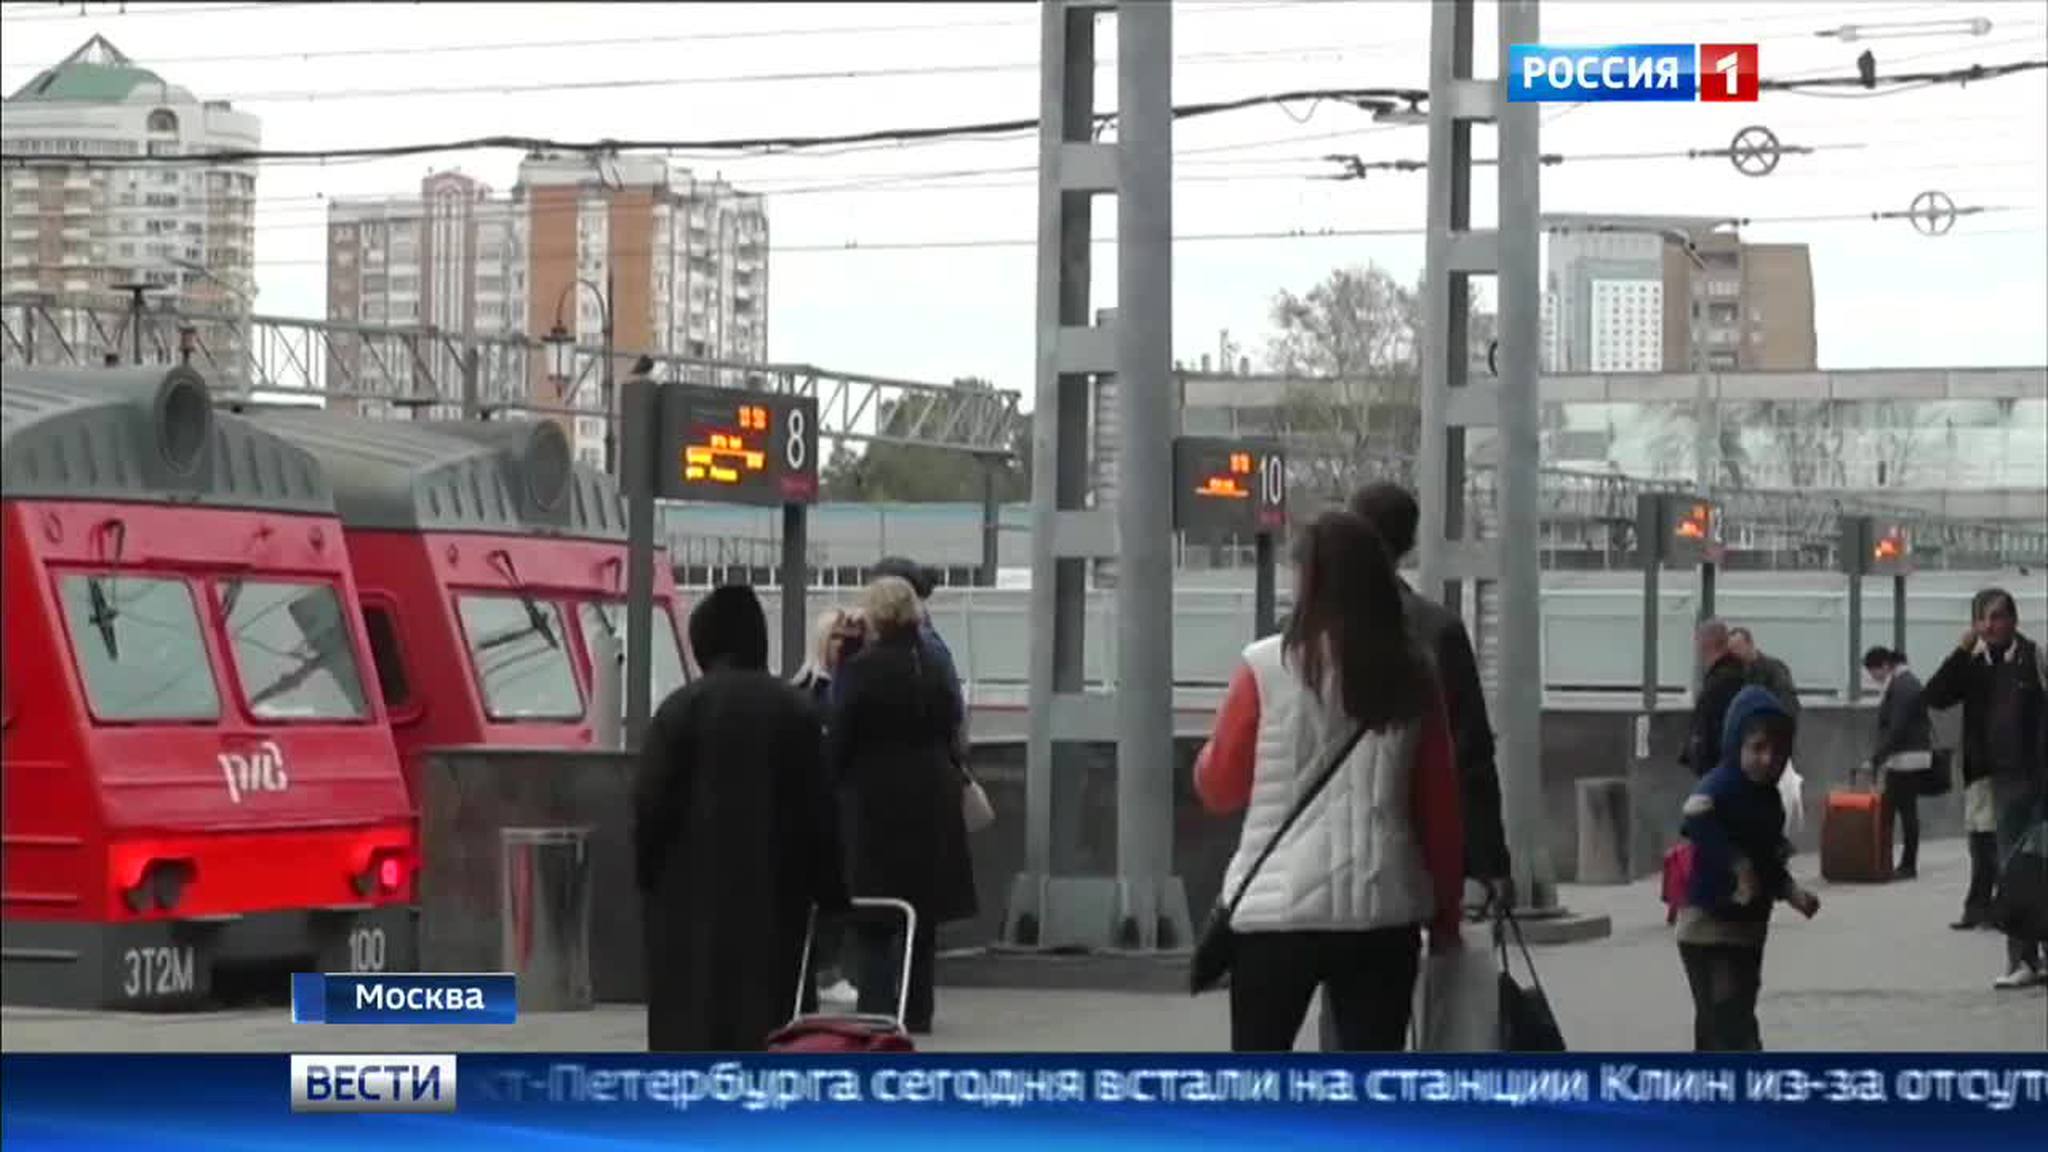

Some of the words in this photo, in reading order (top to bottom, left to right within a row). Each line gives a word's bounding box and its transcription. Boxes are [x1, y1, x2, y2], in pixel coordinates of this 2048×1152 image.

[786, 408, 806, 470] 8
[1259, 454, 1283, 505] 10
[348, 927, 386, 973] 100
